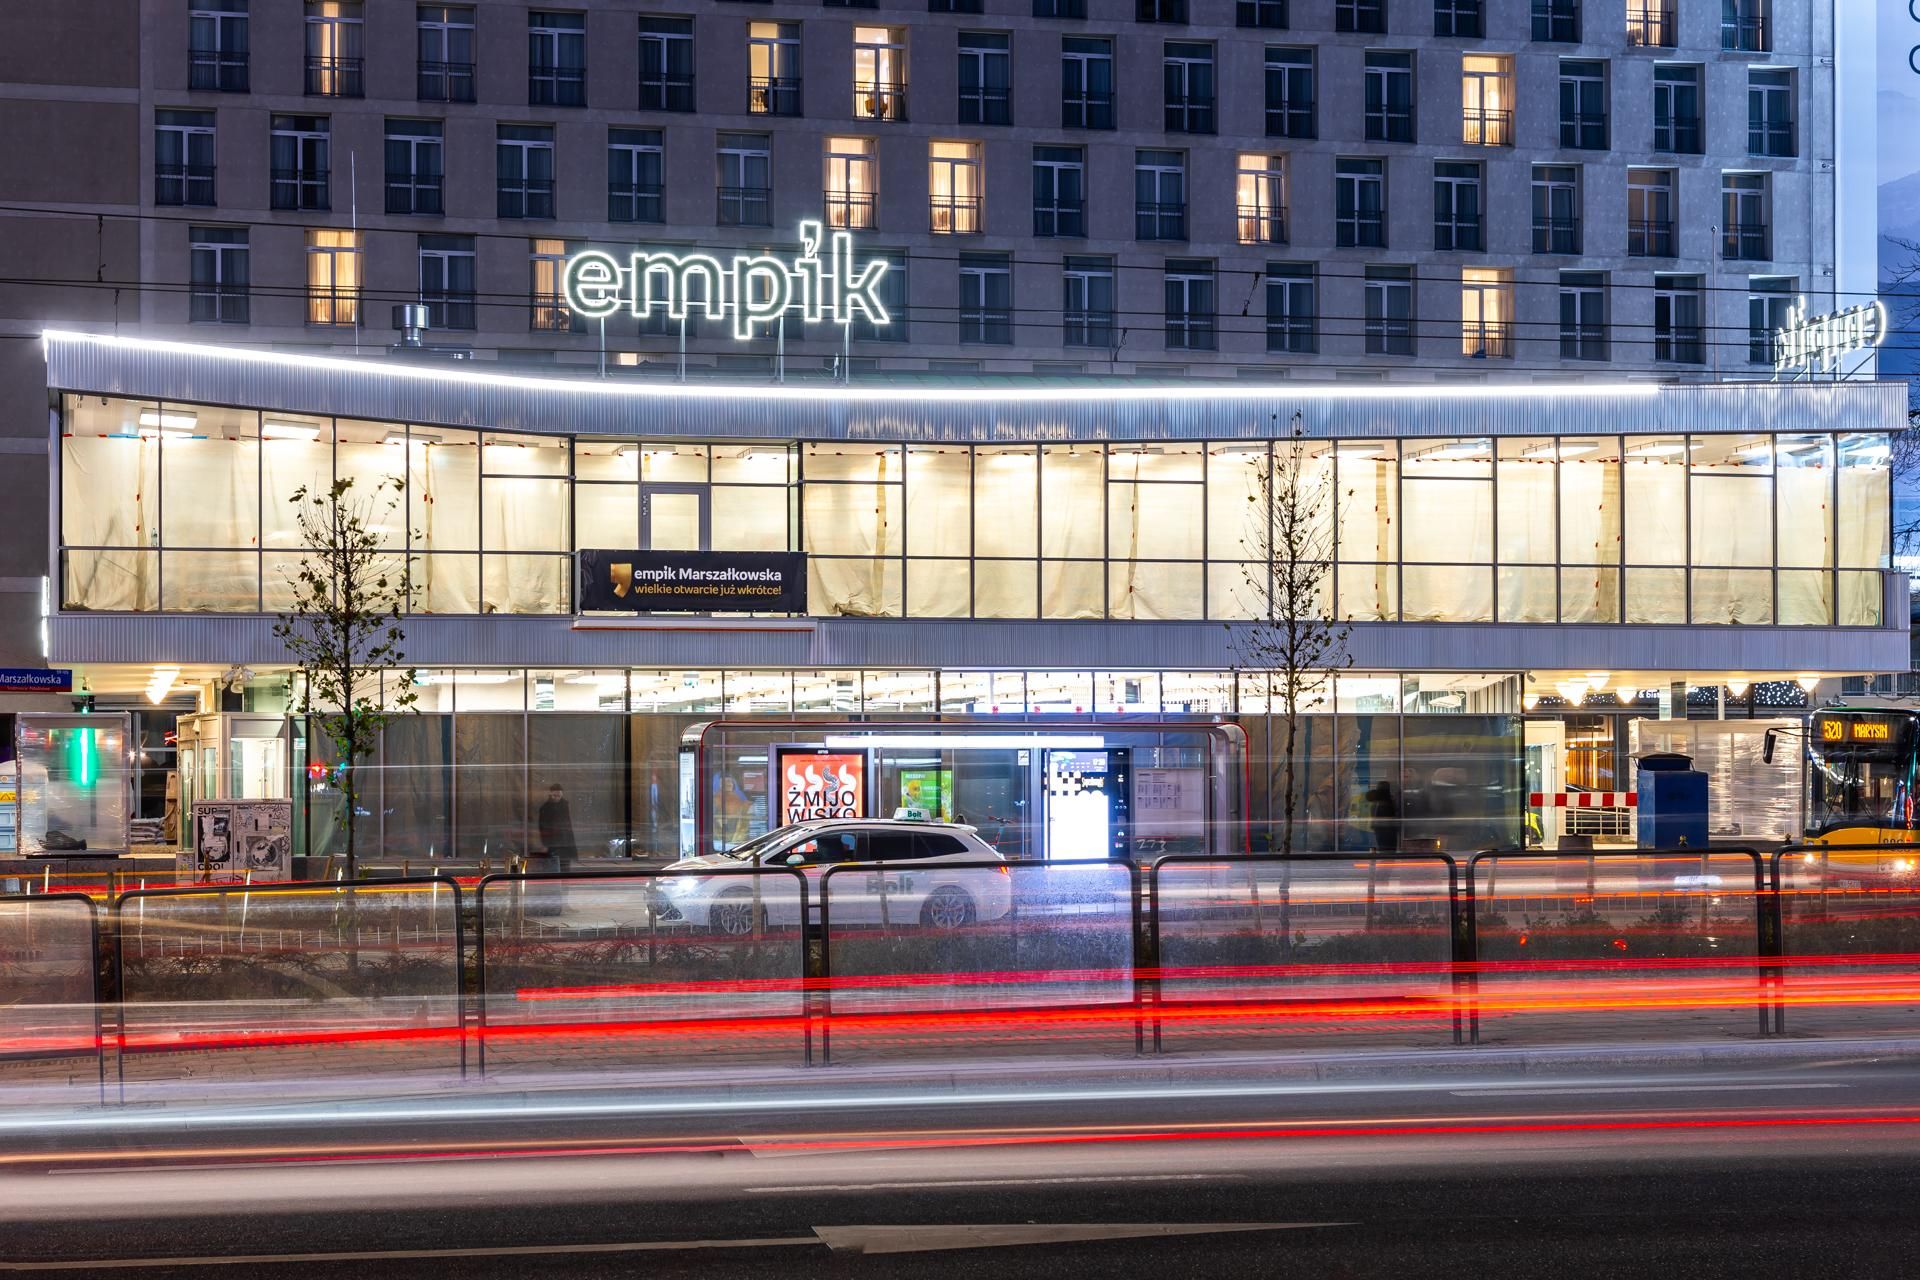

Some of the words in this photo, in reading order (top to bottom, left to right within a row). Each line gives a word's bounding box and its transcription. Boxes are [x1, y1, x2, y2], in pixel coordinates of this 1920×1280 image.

[563, 220, 890, 340] empik
[634, 565, 676, 582] empik
[679, 567, 782, 581] Marszałkowska
[634, 584, 672, 594] wielkie
[673, 584, 718, 595] otwarcie
[720, 584, 735, 597] już
[738, 585, 782, 595] wkrótce!
[1824, 721, 1842, 739] 520
[1854, 724, 1888, 739] MARYSIN
[788, 786, 855, 807] ŻMIJO
[907, 810, 922, 818] Bolt
[866, 874, 914, 895] Bolt
